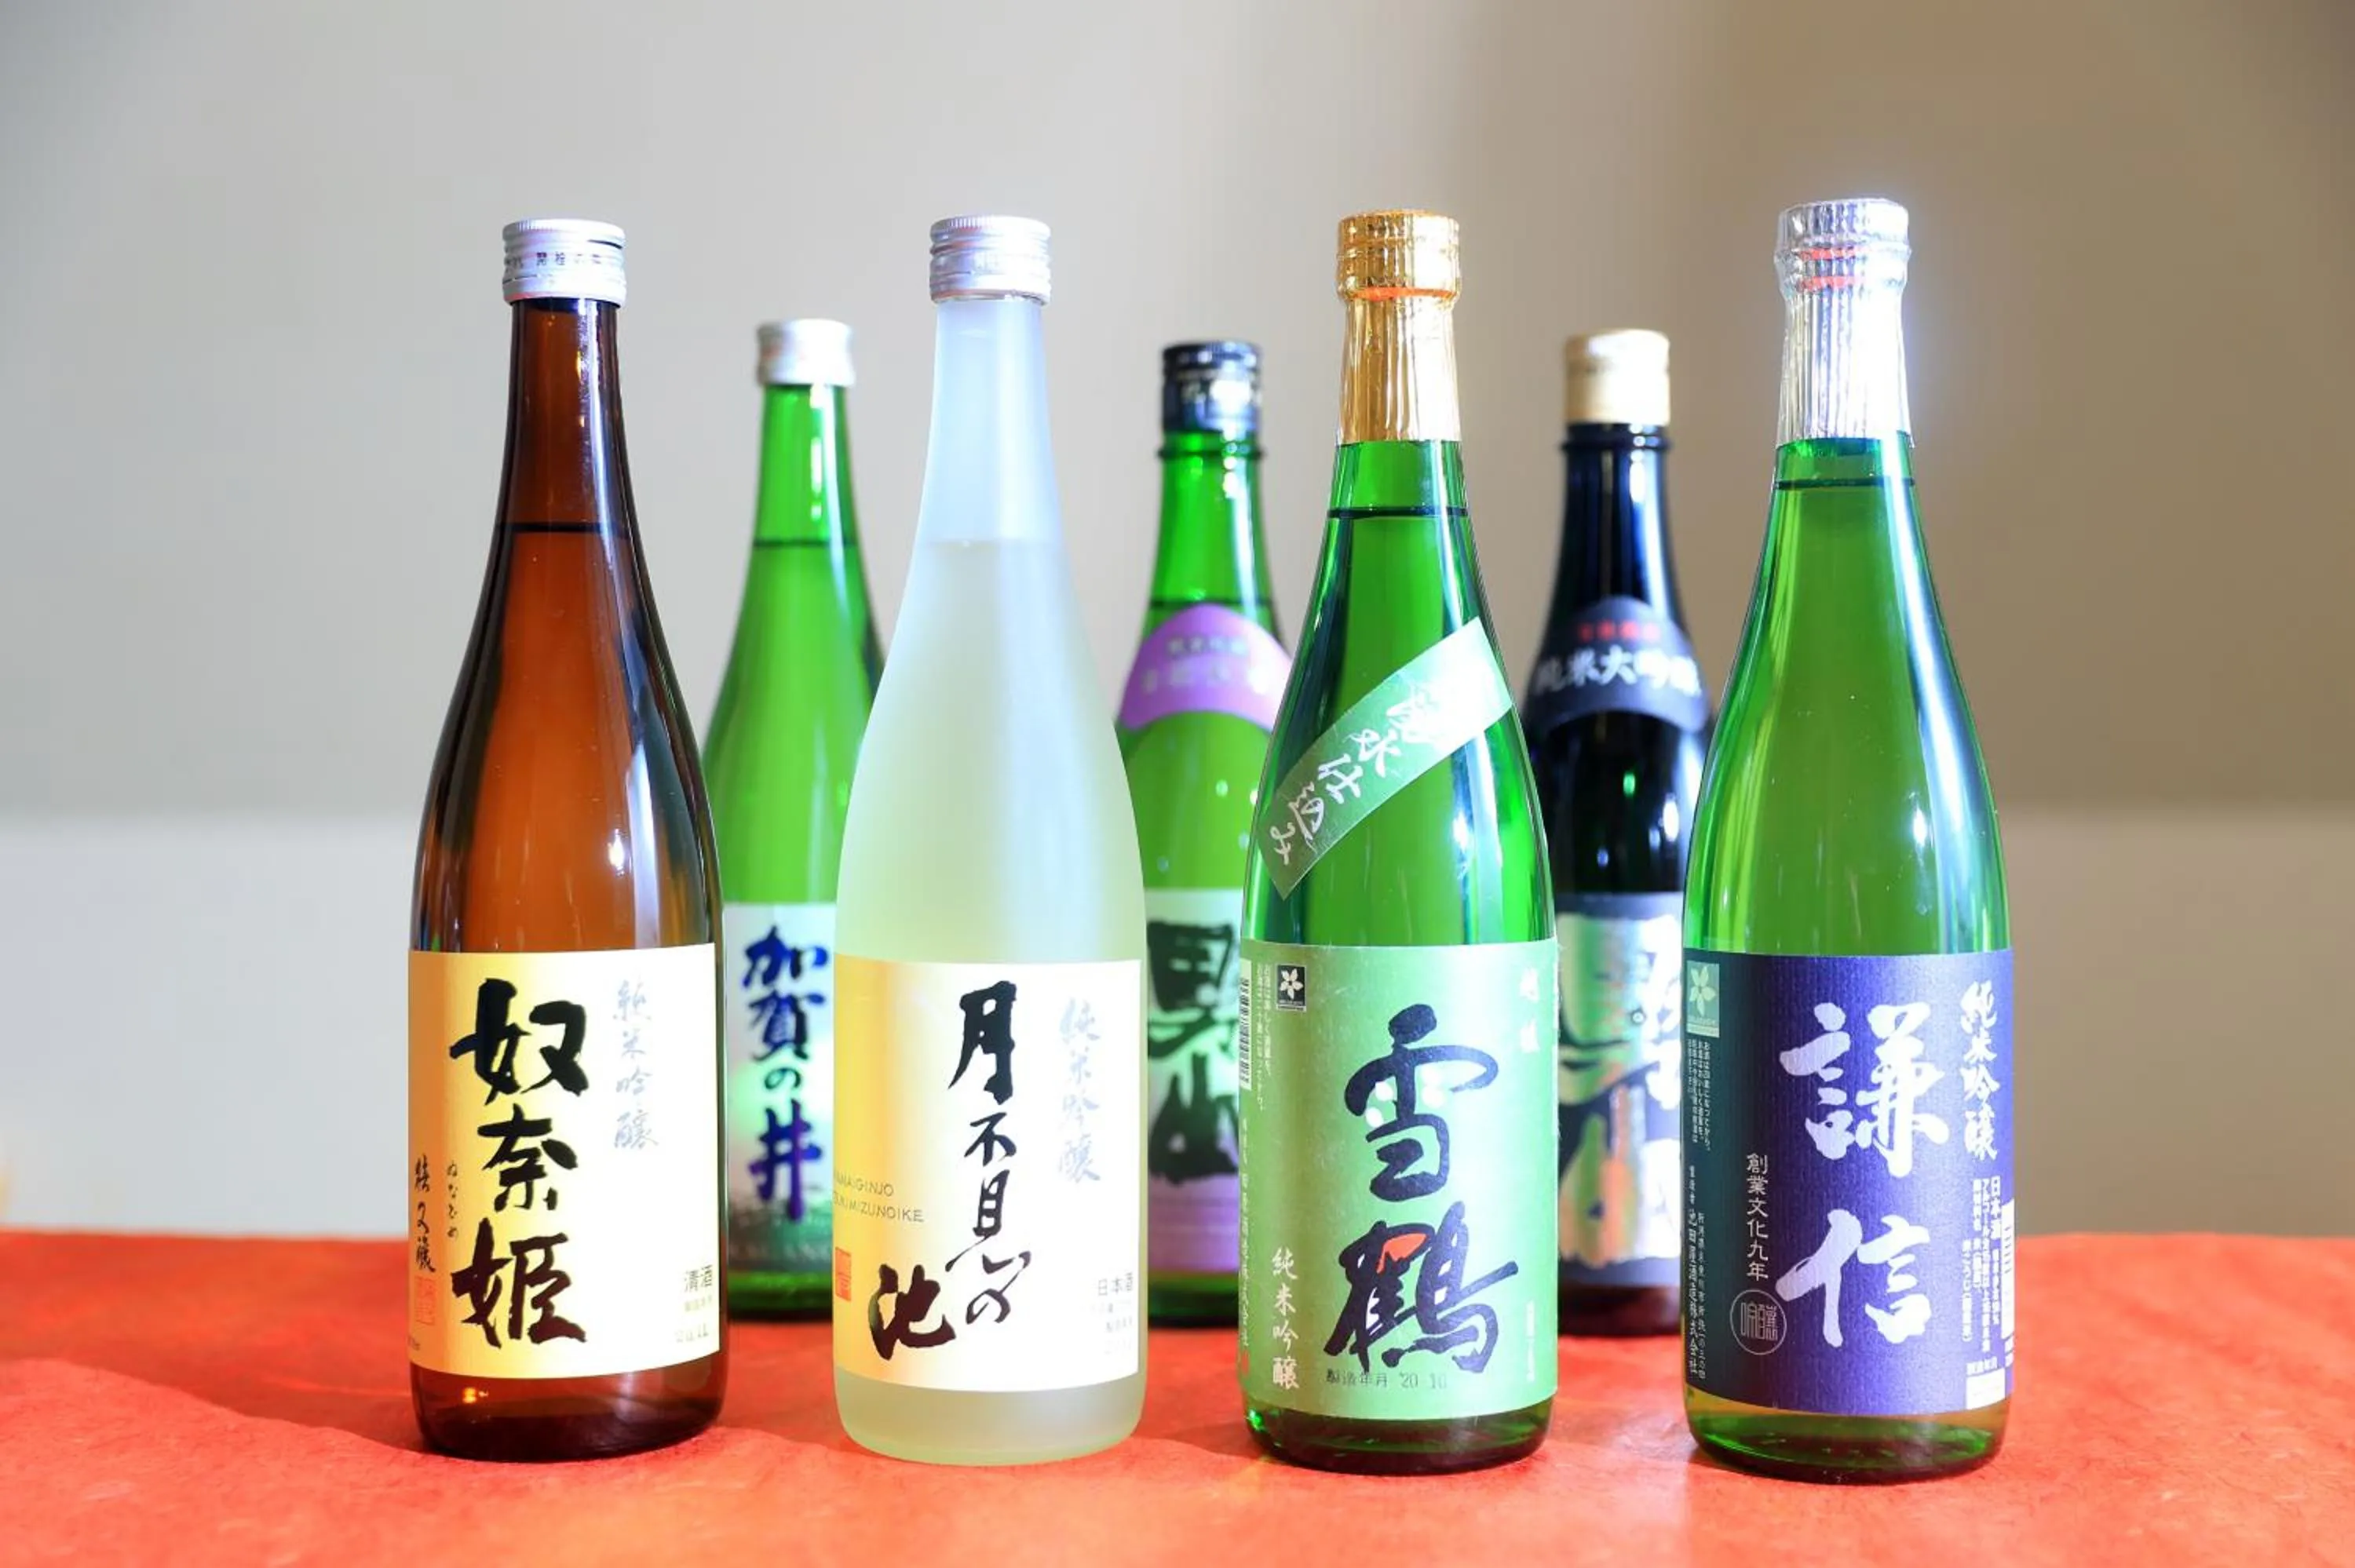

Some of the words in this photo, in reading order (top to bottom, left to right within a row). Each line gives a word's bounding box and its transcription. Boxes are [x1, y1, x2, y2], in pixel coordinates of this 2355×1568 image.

[613, 979, 658, 1150] 純米吟醸
[740, 926, 829, 1224] 加賀の井
[1058, 997, 1102, 1184] 純米吟醸
[1961, 981, 2000, 1161] 純米吟醸
[450, 978, 590, 1348] 奴奈姫
[1323, 1003, 1520, 1375] 雪鶴
[1746, 1152, 1769, 1282] 創業文化九年
[1775, 1002, 1950, 1349] 謙信
[685, 1264, 714, 1293] 清酒
[1270, 1247, 1300, 1390] 純米吟醸
